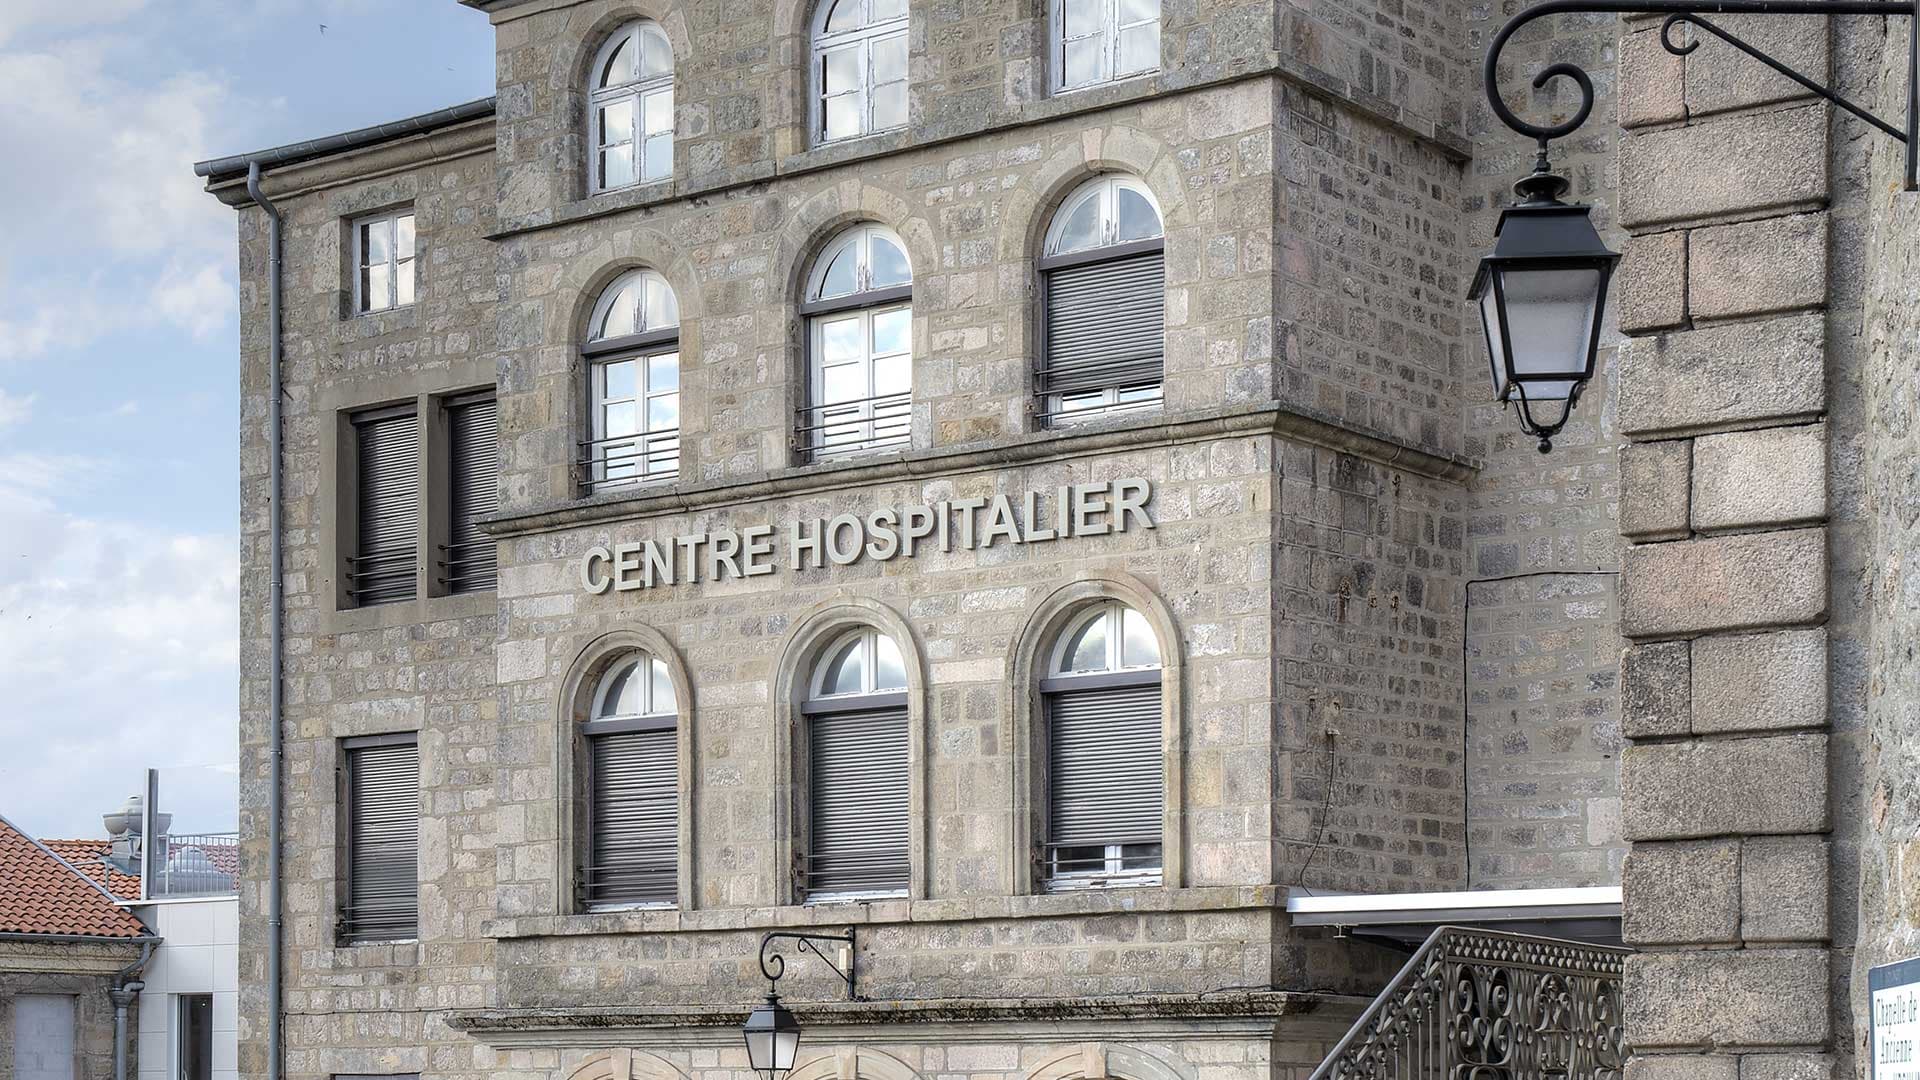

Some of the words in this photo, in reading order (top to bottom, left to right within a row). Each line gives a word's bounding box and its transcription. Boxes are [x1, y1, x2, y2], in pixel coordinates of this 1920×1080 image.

[580, 524, 775, 595] CENTRE
[791, 478, 1156, 571] HOSPITALIER
[1876, 995, 1906, 1034] Chapelle
[1880, 1036, 1912, 1064] Ancienne
